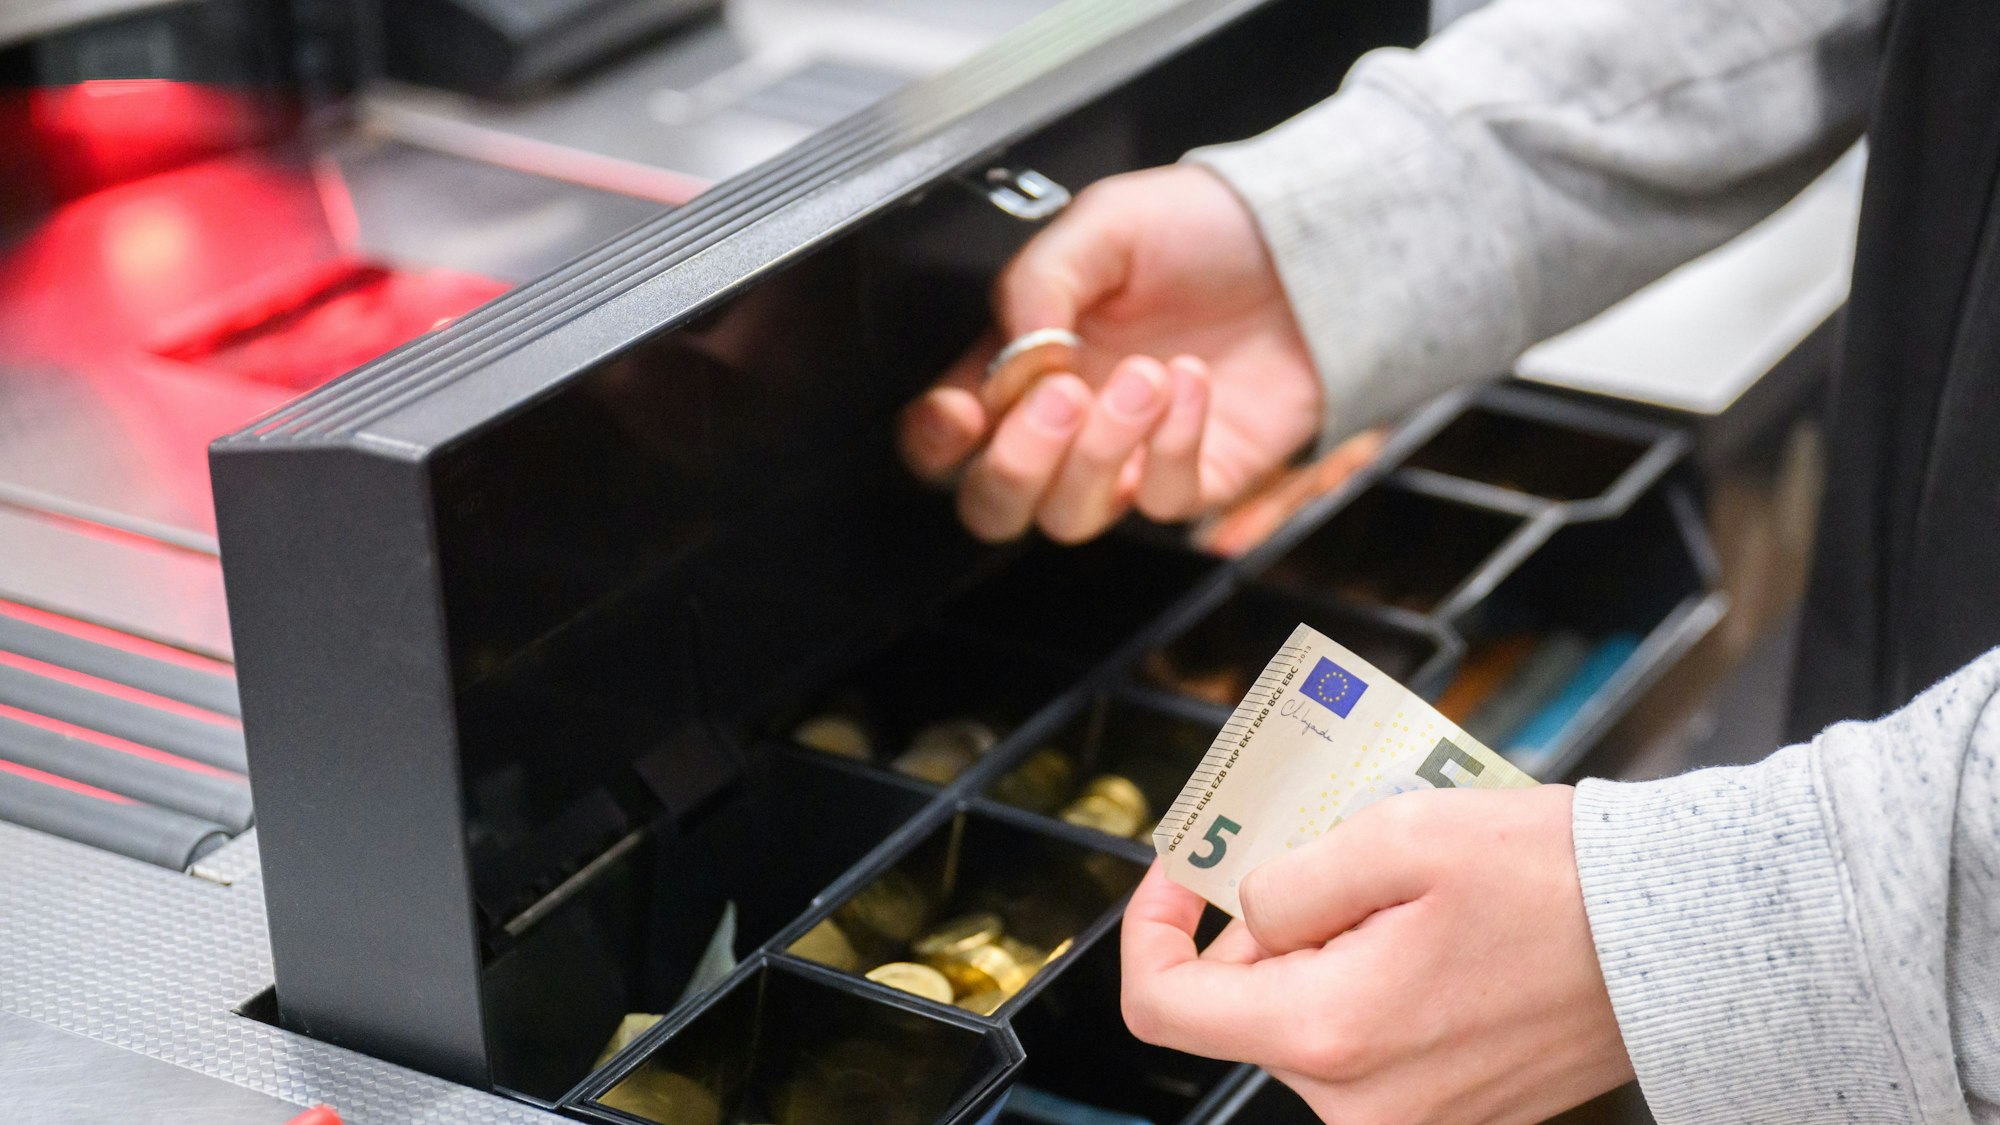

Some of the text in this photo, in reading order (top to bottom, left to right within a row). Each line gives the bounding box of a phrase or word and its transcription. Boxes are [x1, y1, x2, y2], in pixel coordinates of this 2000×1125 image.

[1182, 812, 1198, 831] ECB
[1211, 770, 1226, 789] EZB
[1225, 749, 1239, 769] EKP
[1253, 708, 1269, 728] EKB
[1282, 666, 1298, 686] EBC
[1297, 646, 1311, 663] 2013
[1188, 815, 1242, 869] 5
